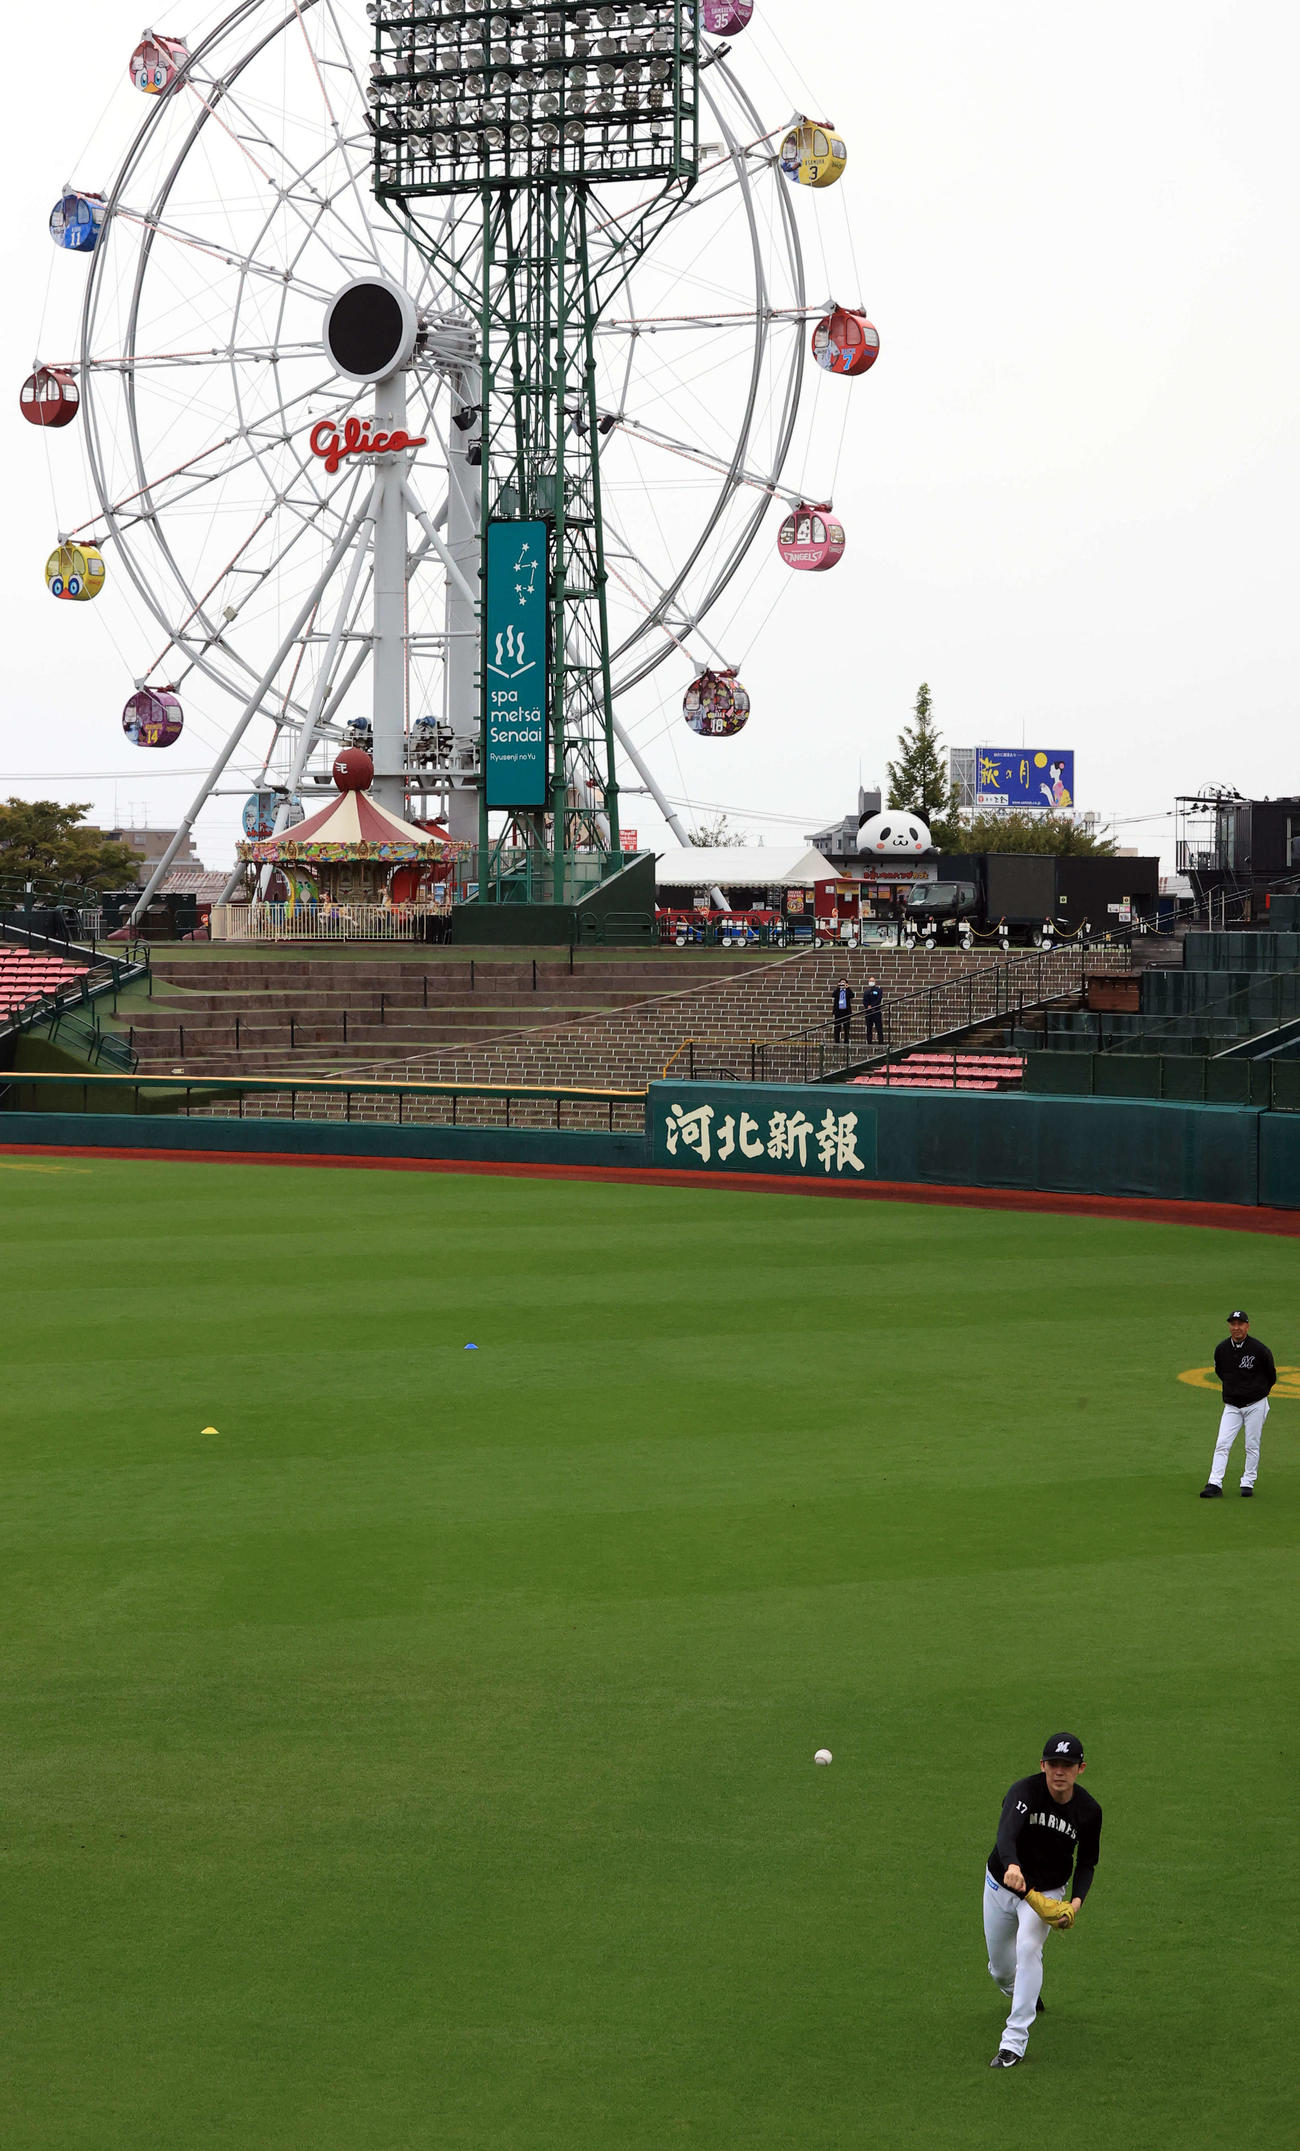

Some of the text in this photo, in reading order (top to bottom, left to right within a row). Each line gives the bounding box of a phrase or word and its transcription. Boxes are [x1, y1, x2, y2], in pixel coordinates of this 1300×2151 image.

[714, 13, 729, 29] 35
[809, 166, 818, 180] 3
[71, 232, 80, 246] 11
[843, 354, 853, 371] 7
[310, 417, 427, 473] Glico
[491, 691, 518, 707] spa
[491, 707, 541, 722] metsä
[711, 719, 723, 733] 18
[147, 729, 158, 744] 14
[490, 727, 542, 742] Sendai
[665, 1103, 865, 1172] 河北新報
[1016, 1800, 1028, 1814] 17
[1029, 1812, 1078, 1840] MARINES
